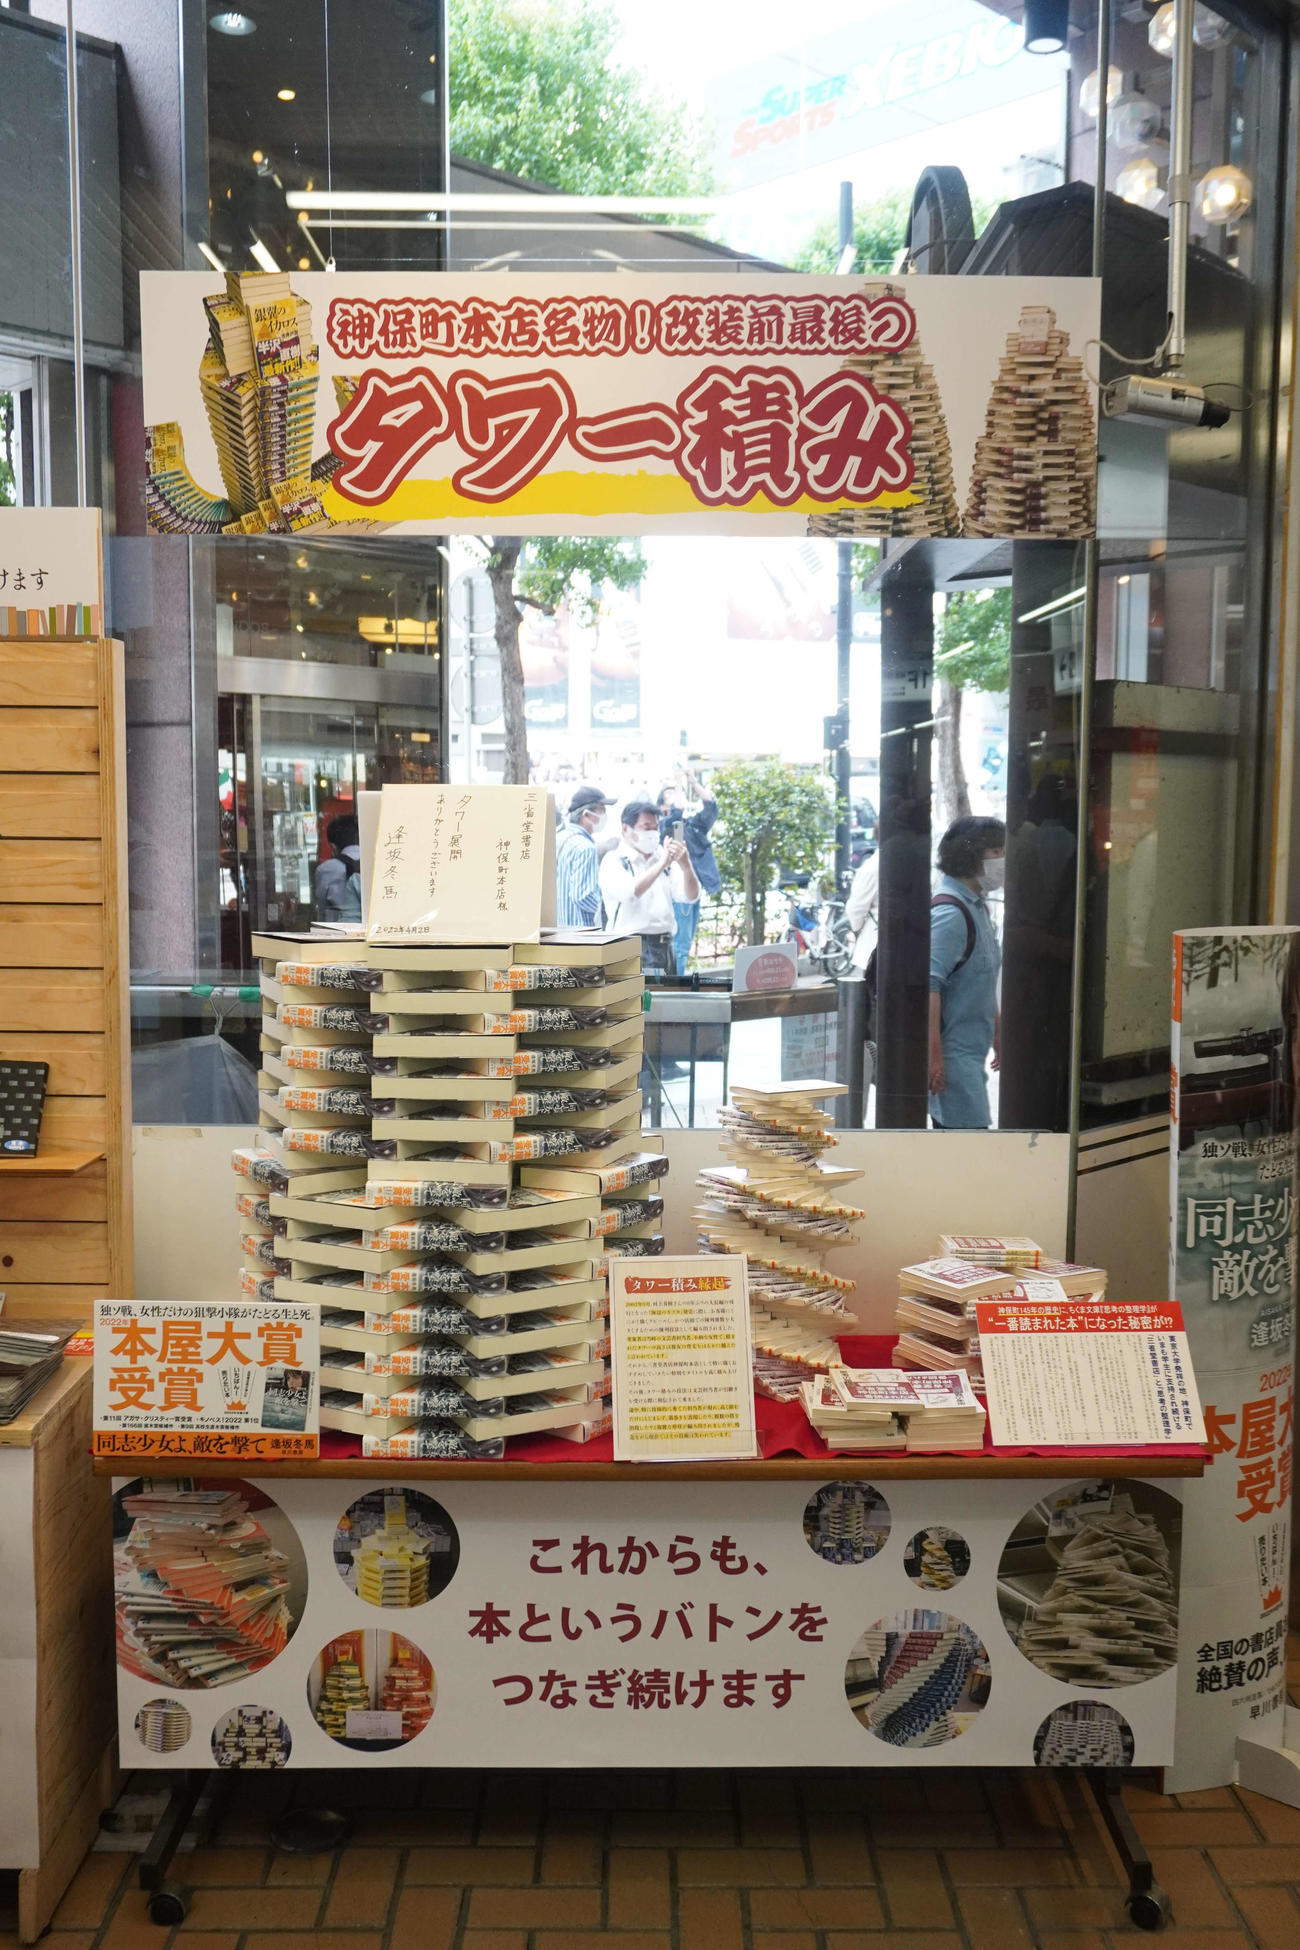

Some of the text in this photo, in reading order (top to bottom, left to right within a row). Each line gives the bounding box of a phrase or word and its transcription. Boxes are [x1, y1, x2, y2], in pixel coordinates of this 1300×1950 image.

[841, 15, 1026, 120] XEBIO
[759, 74, 848, 124] SUPER
[731, 100, 838, 159] SPORTS
[329, 296, 916, 357] 神保町本店名物！改装前最後の
[327, 366, 915, 506] タワー積み
[428, 793, 447, 898] ありがとうございます
[449, 794, 473, 861] タワー展開
[519, 792, 538, 860] 三省堂書店
[495, 837, 511, 912] 神保町本店様
[100, 1318, 129, 1327] 2022年
[110, 1319, 304, 1368] 本屋大賞
[108, 1366, 205, 1412] 受賞
[97, 1434, 267, 1455] 同志少女よ、敵を撃て
[270, 1438, 315, 1450] 逢坂冬馬
[529, 1535, 768, 1577] これからも、
[467, 1601, 829, 1644] 本というバトンを
[492, 1669, 806, 1710] つなぎ続けます
